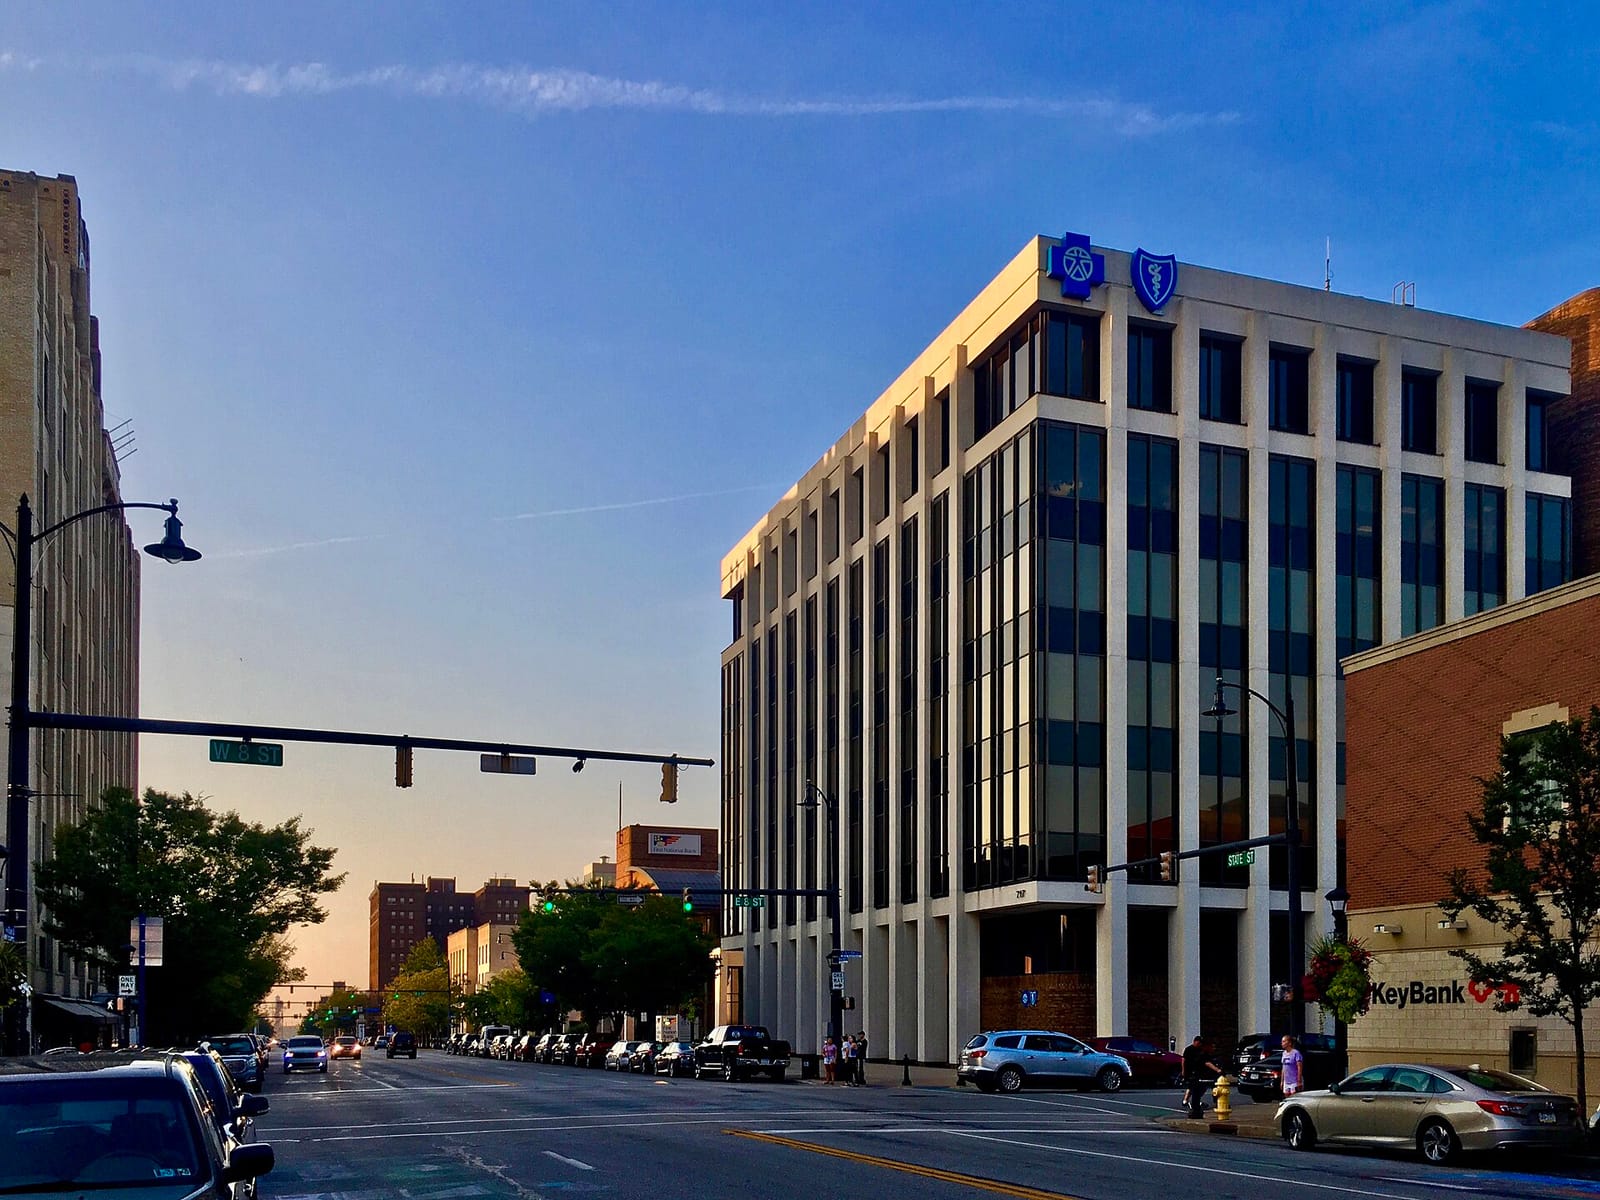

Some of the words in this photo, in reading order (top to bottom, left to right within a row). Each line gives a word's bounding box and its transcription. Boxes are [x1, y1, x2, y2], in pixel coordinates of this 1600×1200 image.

[211, 741, 230, 760] W
[238, 744, 250, 761] 8
[258, 745, 281, 764] ST
[1228, 853, 1243, 867] STATE
[1246, 851, 1254, 863] ST
[735, 897, 741, 906] E
[743, 897, 750, 906] 8
[752, 897, 763, 907] ST
[1372, 980, 1465, 1009] KeyBank
